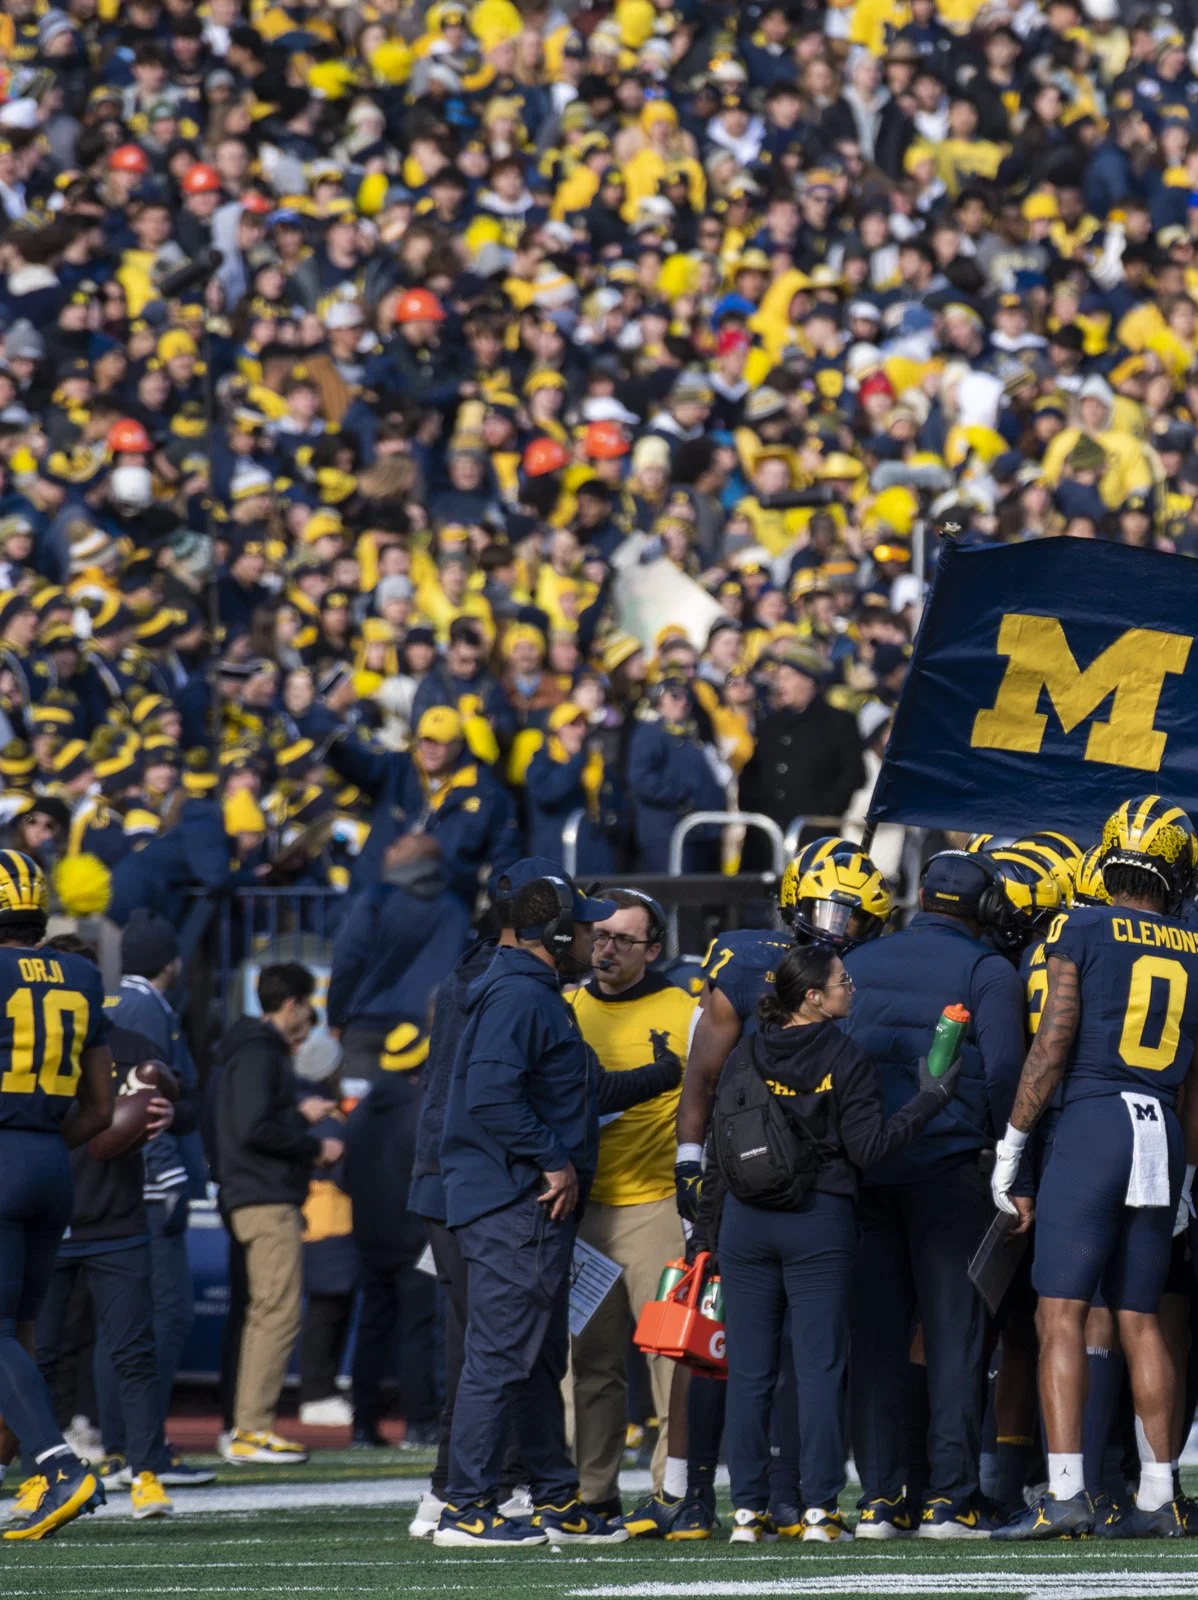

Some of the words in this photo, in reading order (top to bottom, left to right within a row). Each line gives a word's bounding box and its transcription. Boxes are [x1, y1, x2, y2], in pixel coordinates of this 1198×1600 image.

[970, 613, 1194, 772] M
[17, 958, 65, 984] ORJI
[1118, 954, 1189, 1072] 0
[1, 987, 90, 1097] 10
[1133, 1103, 1158, 1122] M
